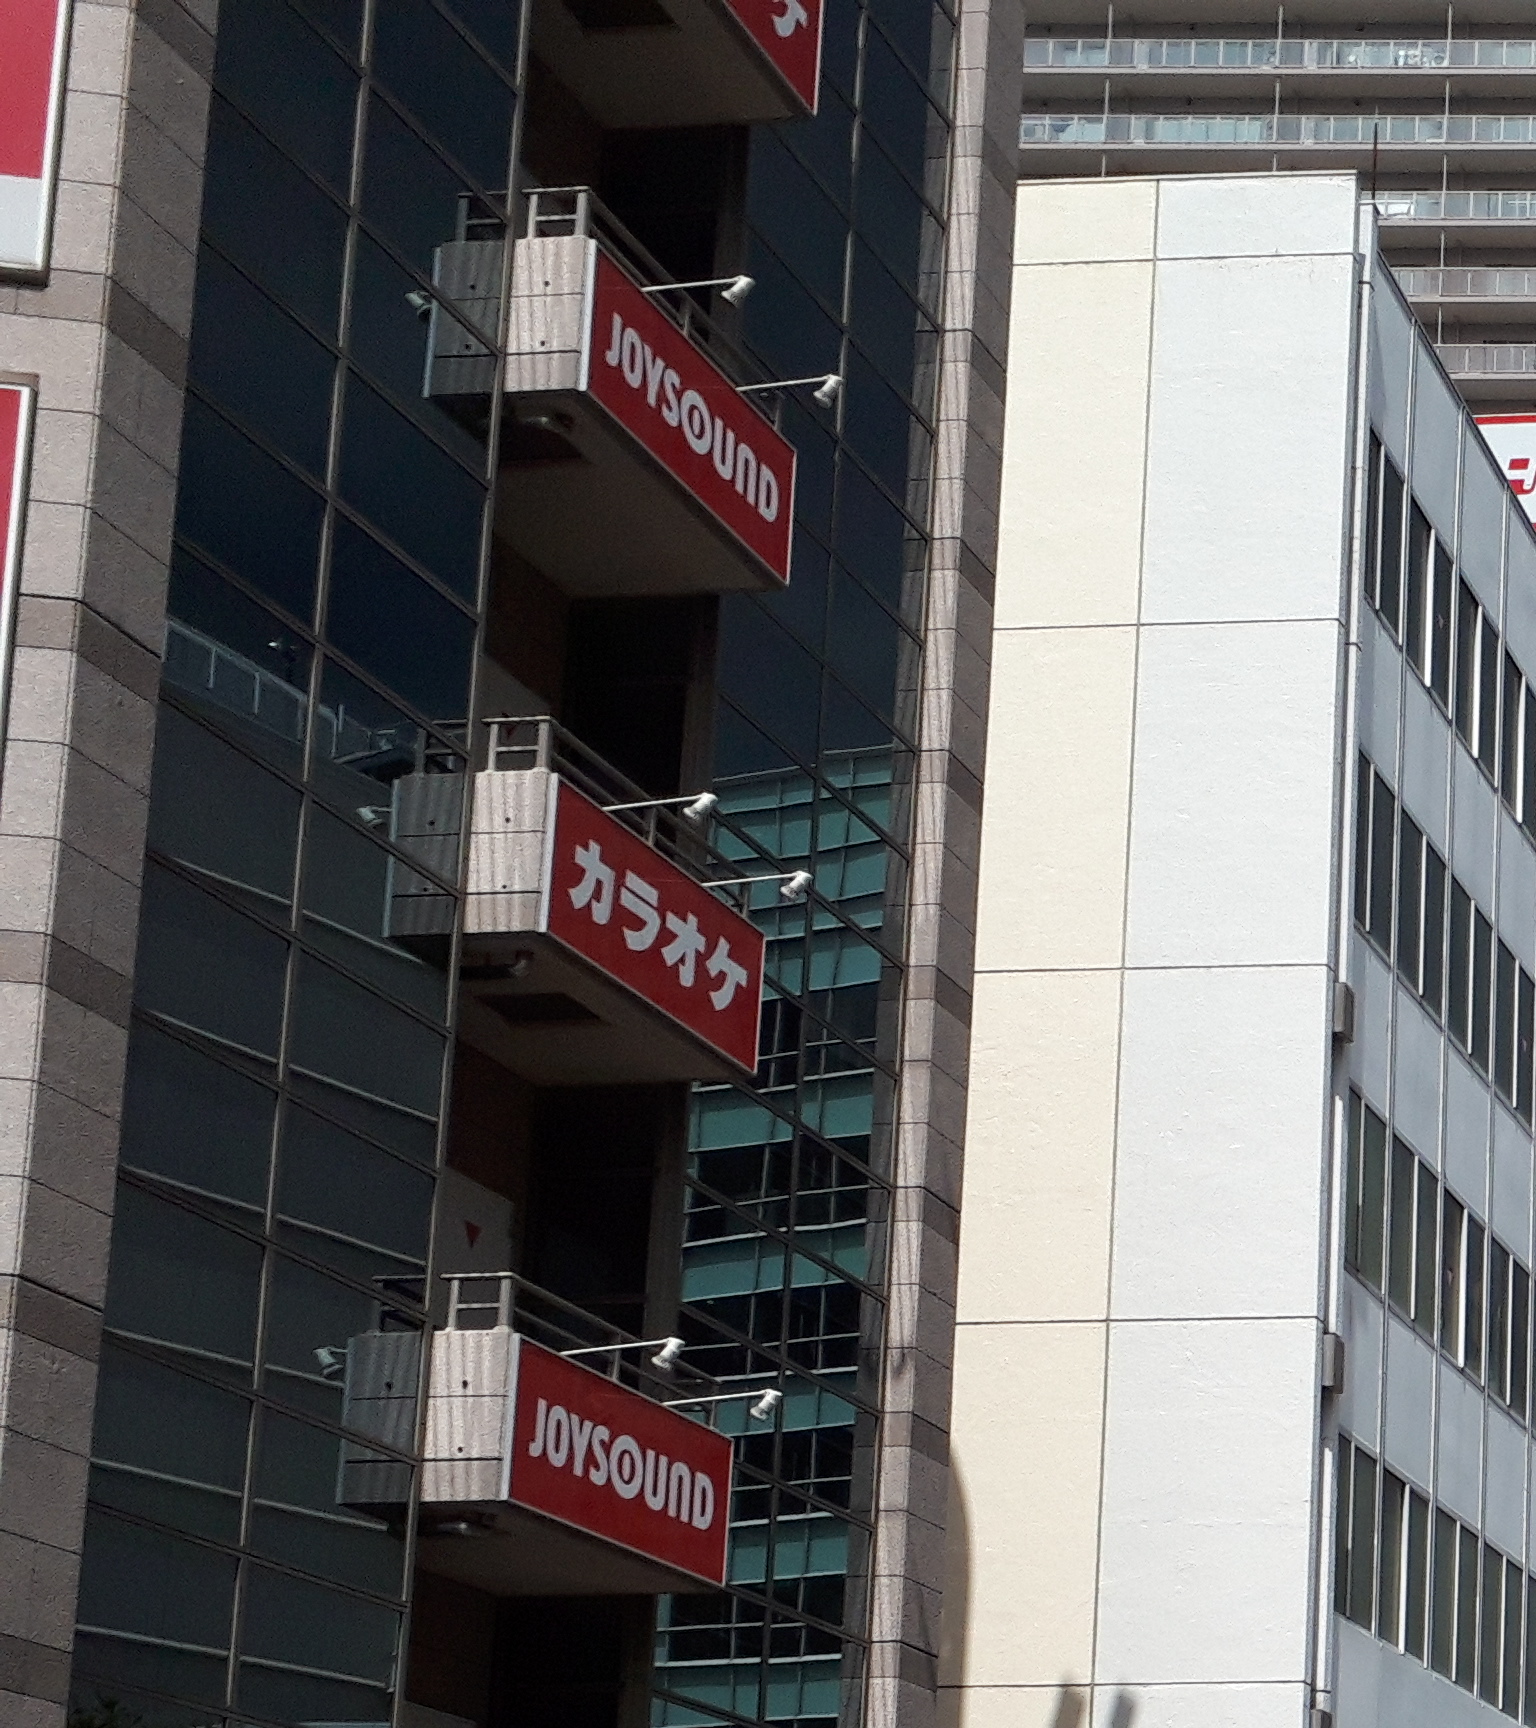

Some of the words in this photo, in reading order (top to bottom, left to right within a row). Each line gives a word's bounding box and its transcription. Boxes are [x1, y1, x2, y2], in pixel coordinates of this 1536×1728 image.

[606, 313, 779, 523] JOYSOUND
[568, 838, 748, 1011] カラオケ
[529, 1396, 715, 1531] JOYSOUND
